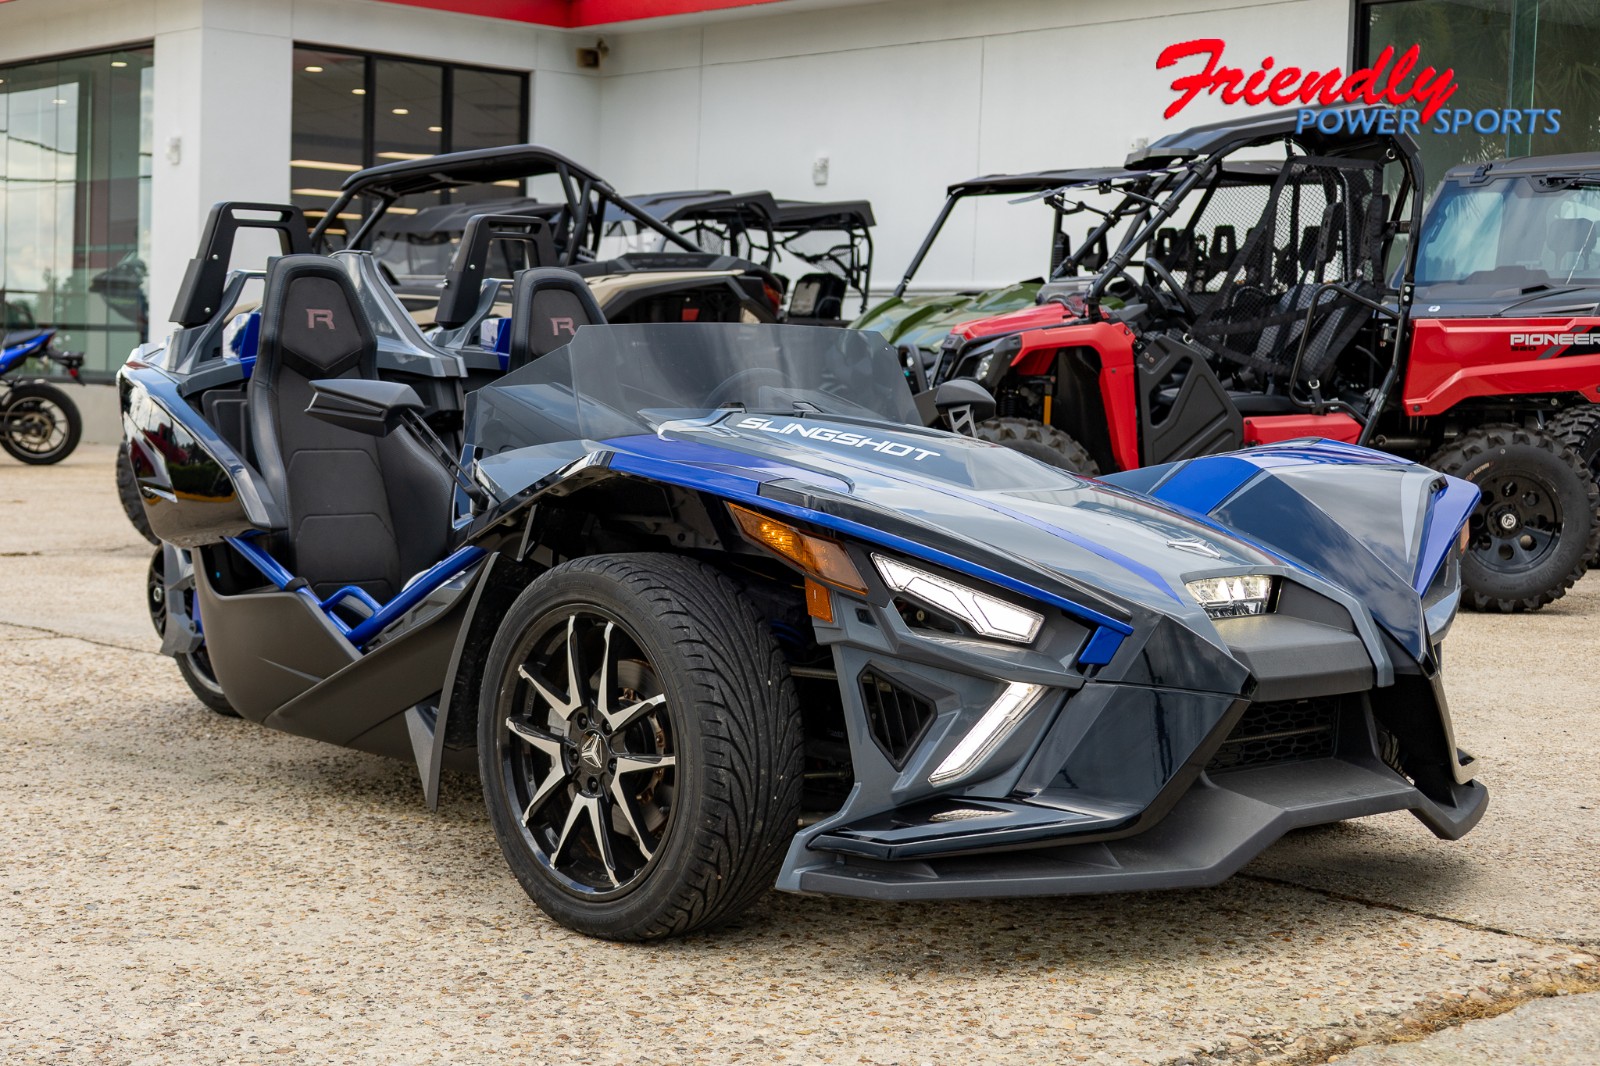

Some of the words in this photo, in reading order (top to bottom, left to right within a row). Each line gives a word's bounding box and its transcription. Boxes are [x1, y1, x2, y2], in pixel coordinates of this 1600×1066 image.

[305, 308, 336, 330] R
[550, 317, 576, 336] R
[736, 417, 941, 461] SLINGSHOT
